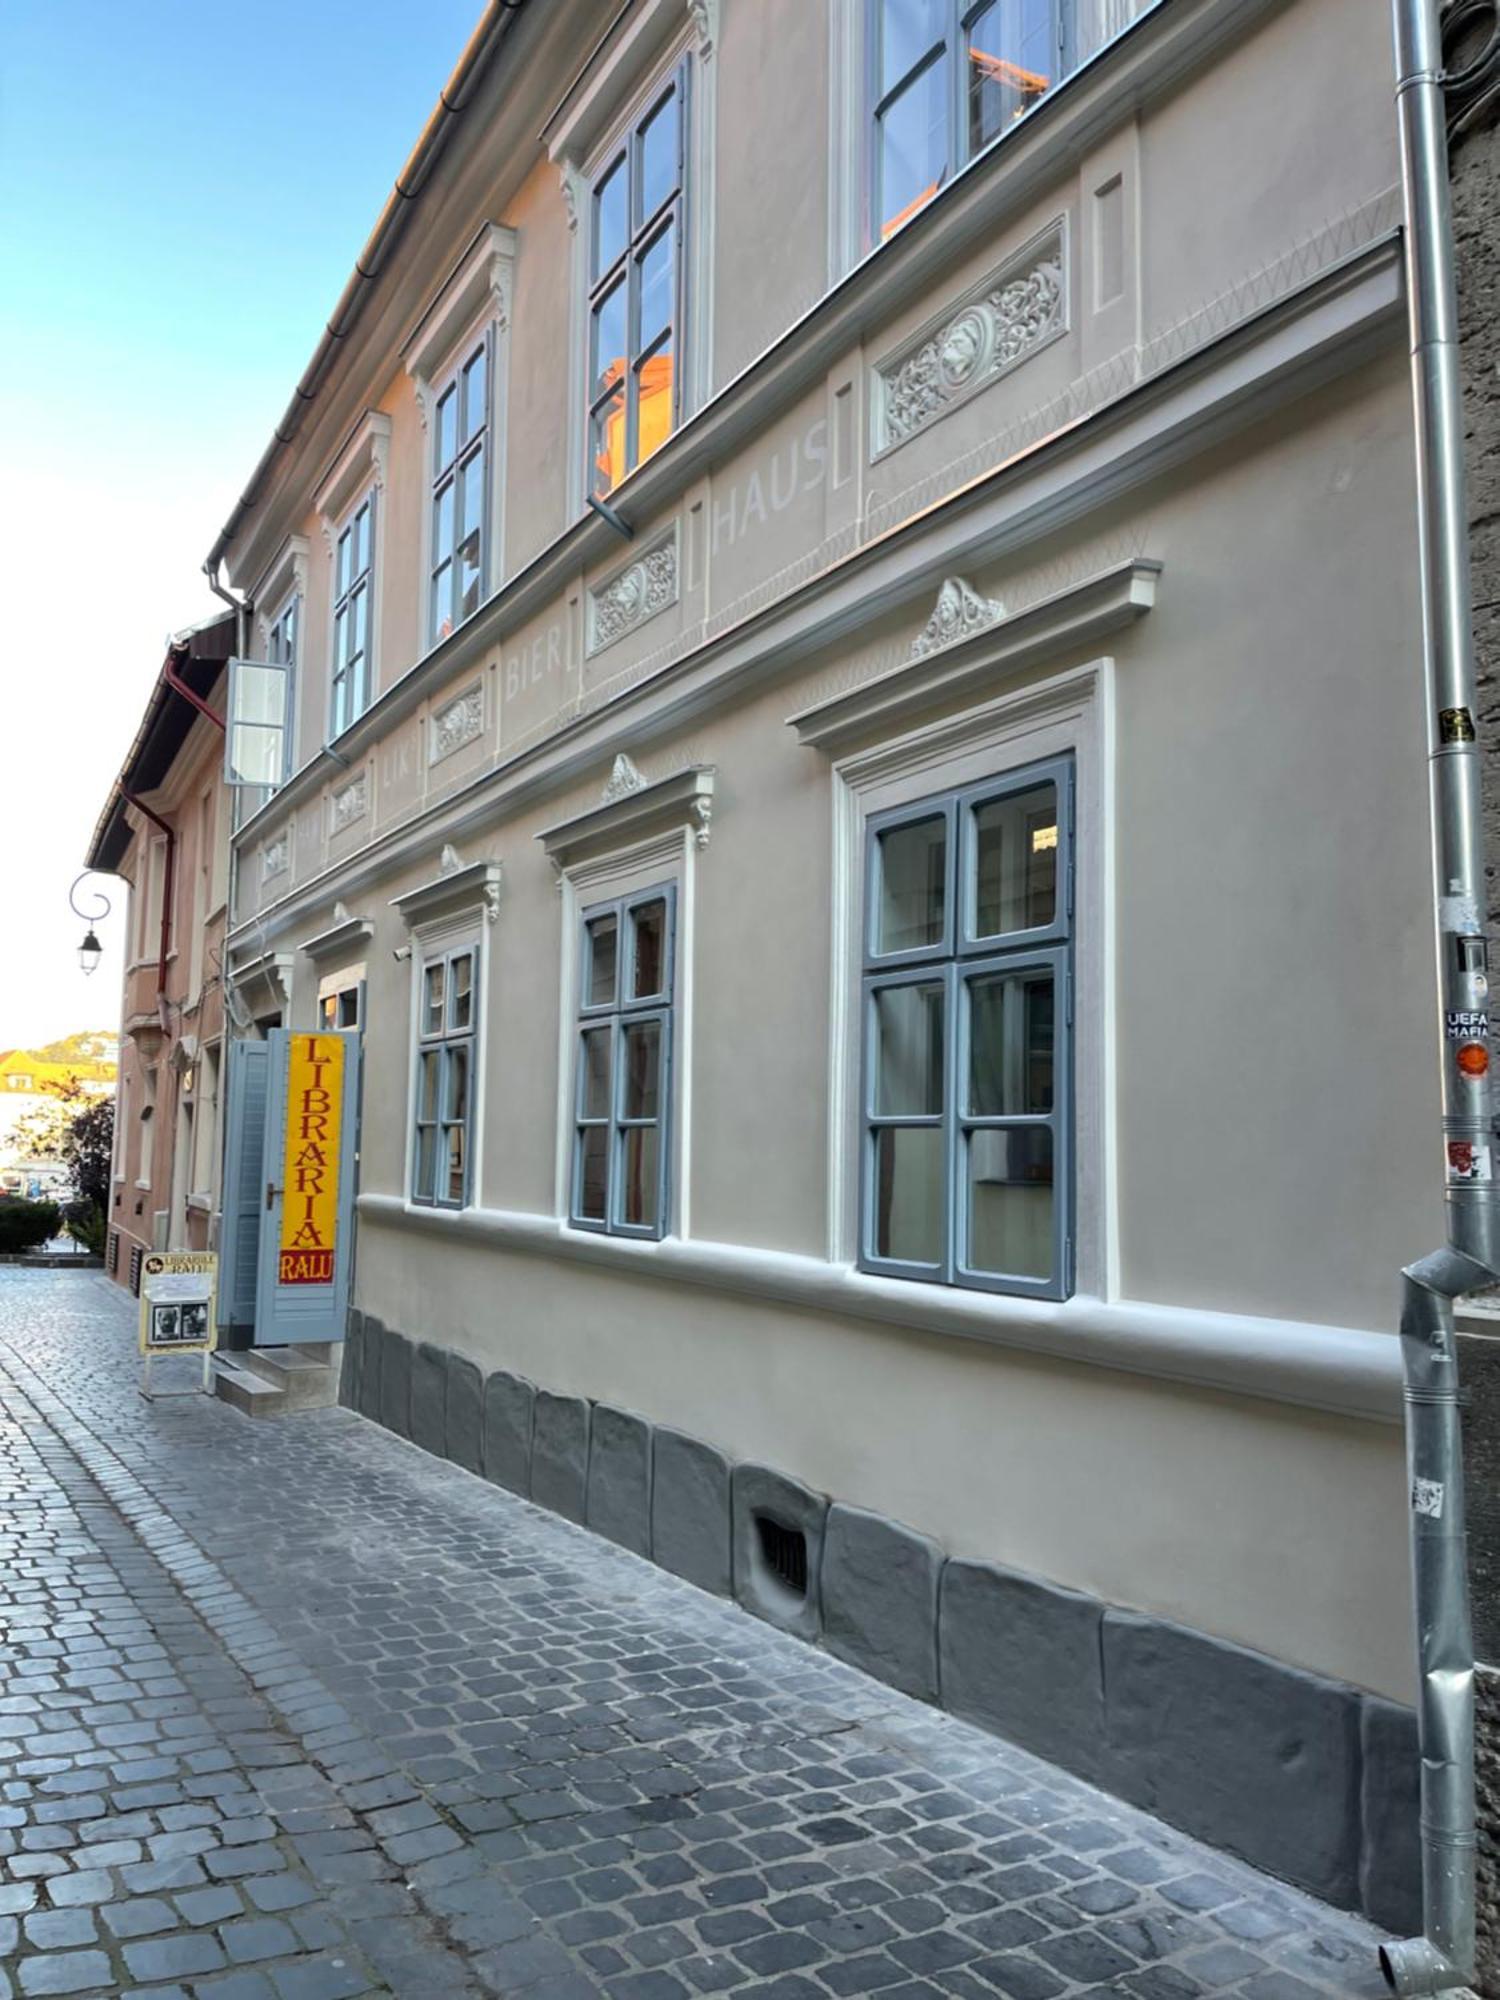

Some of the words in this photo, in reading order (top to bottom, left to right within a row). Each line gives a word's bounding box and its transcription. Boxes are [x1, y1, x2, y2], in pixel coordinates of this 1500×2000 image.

[505, 624, 561, 703] BIER
[712, 418, 827, 556] HAUS
[1448, 1012, 1488, 1025] UEFA
[1448, 1026, 1488, 1038] MAFIA
[291, 1037, 332, 1248] LIBRARIA
[280, 1255, 333, 1281] RALU
